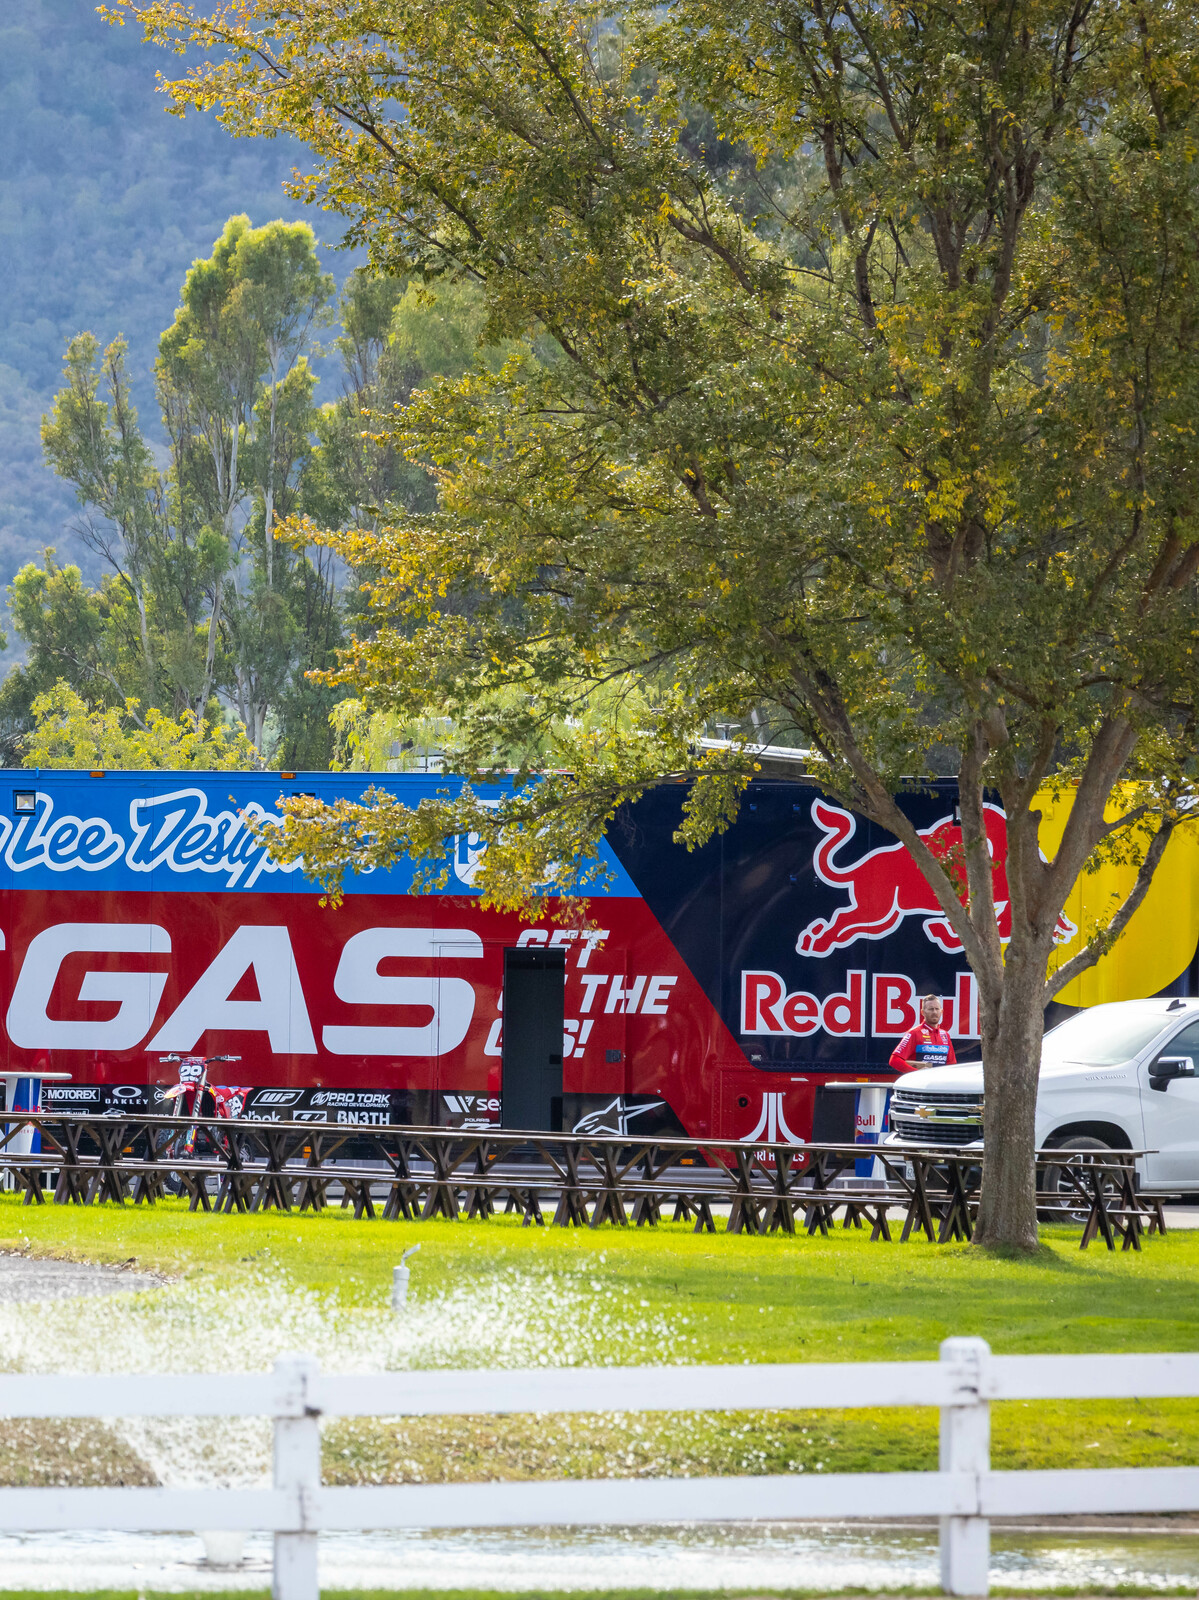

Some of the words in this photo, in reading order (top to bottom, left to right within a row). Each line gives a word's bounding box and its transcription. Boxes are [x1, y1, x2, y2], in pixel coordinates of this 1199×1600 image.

[7, 791, 124, 873] Lee
[125, 787, 377, 888] Desig
[579, 974, 678, 1015] THE
[740, 970, 867, 1038] Red
[871, 972, 981, 1040] Bul
[47, 1089, 97, 1100] MOTOREX
[259, 1092, 296, 1103] WP
[327, 1092, 356, 1103] PRO
[355, 1093, 391, 1104] TORK
[337, 1110, 391, 1126] BN3TH
[856, 1115, 876, 1127] Bull
